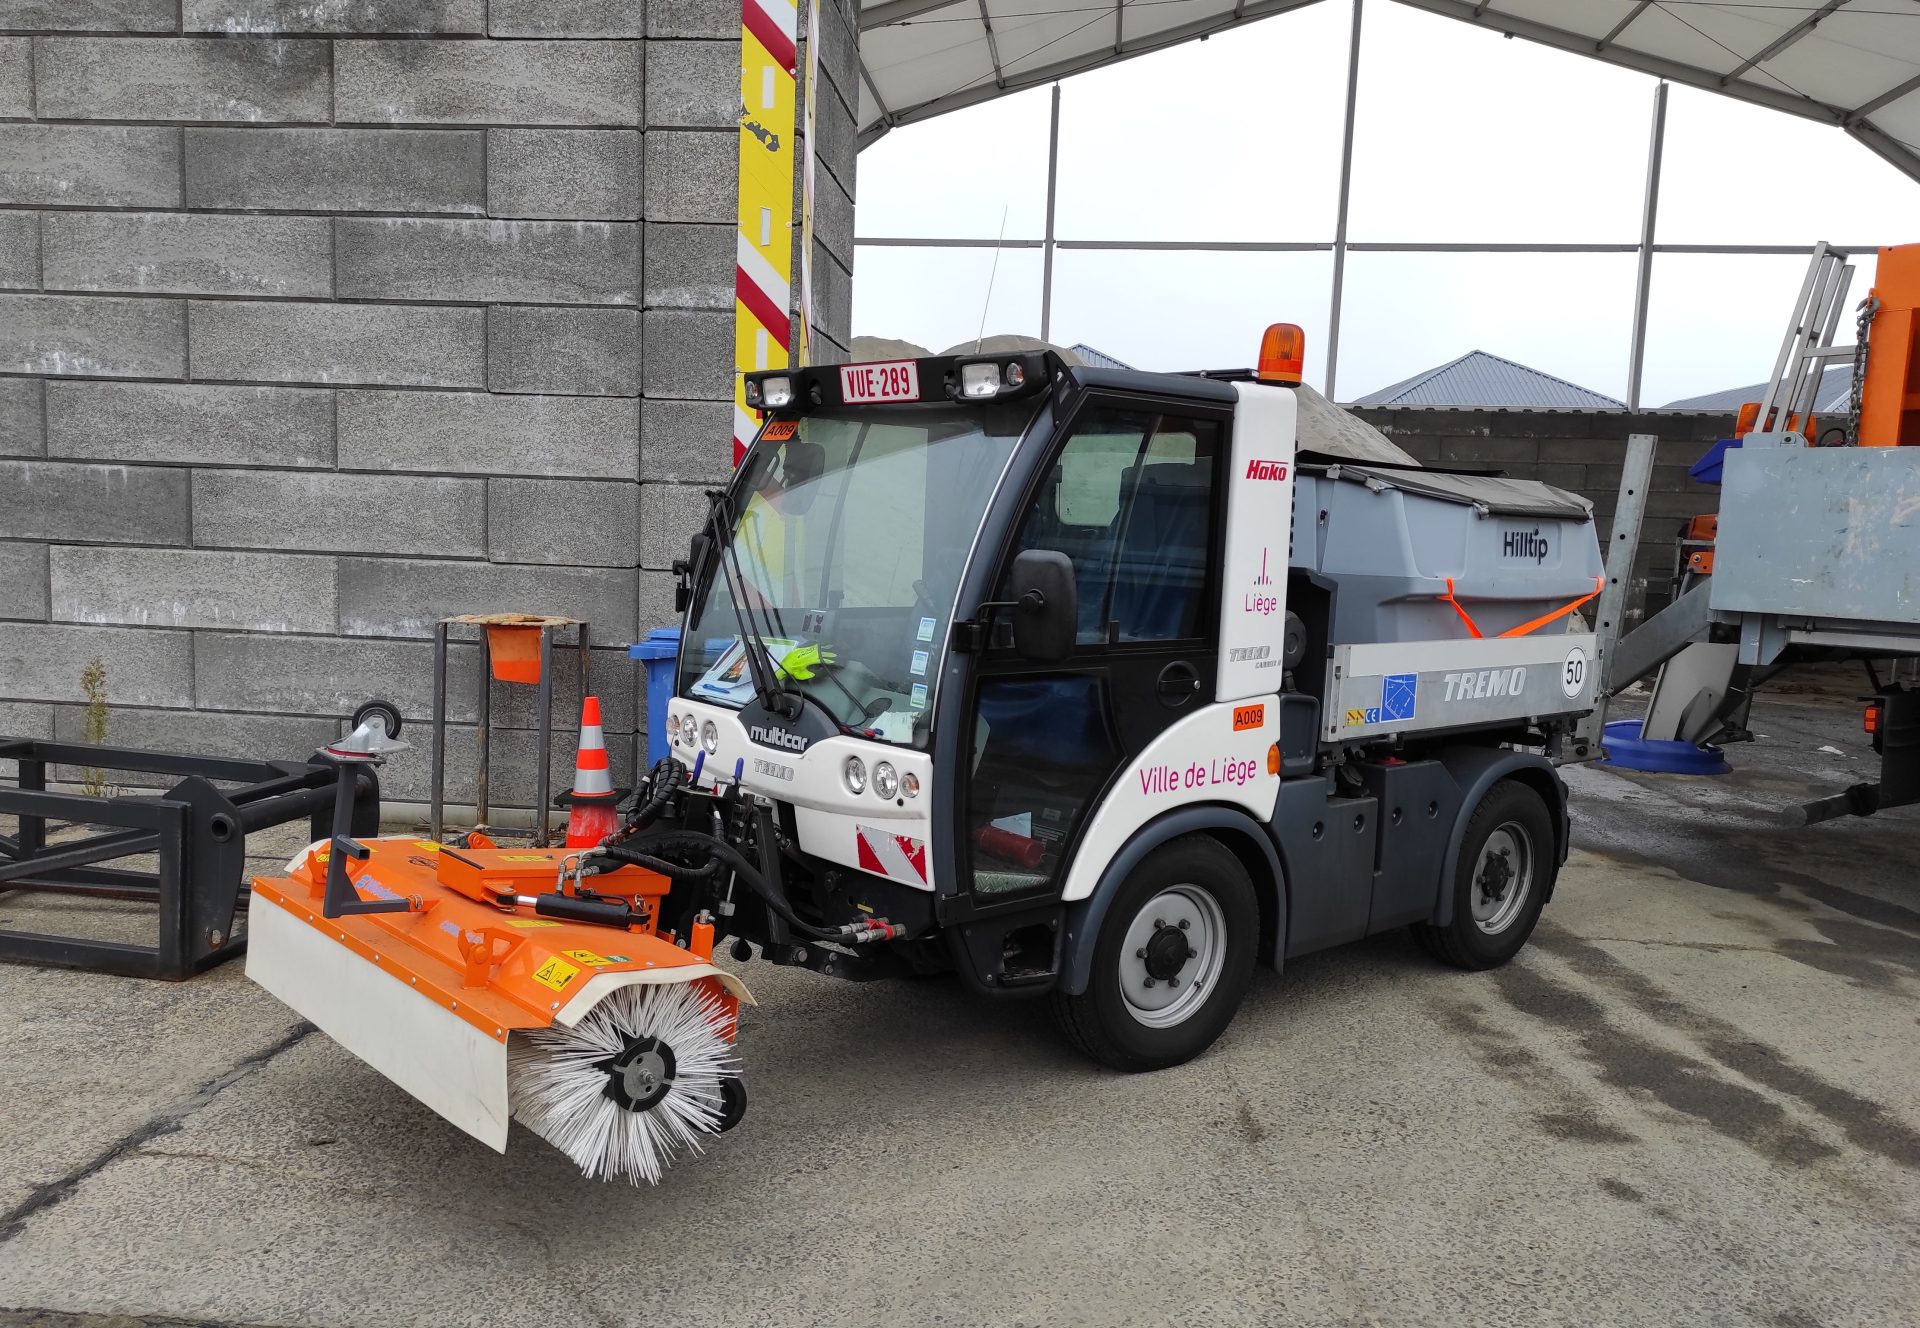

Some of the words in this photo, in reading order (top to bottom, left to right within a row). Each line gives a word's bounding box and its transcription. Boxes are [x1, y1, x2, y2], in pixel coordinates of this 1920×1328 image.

[766, 424, 794, 437] A009
[1245, 459, 1288, 482] Hako
[1503, 528, 1549, 566] Hilltip
[1244, 592, 1278, 616] Liège
[1443, 666, 1527, 702] TREMO
[1565, 659, 1583, 686] 50
[1234, 708, 1264, 727] A009
[1365, 709, 1377, 723] CE
[750, 725, 808, 751] multicar
[1139, 765, 1179, 796] Ville
[1184, 761, 1206, 789] de
[1210, 756, 1257, 787] Liège
